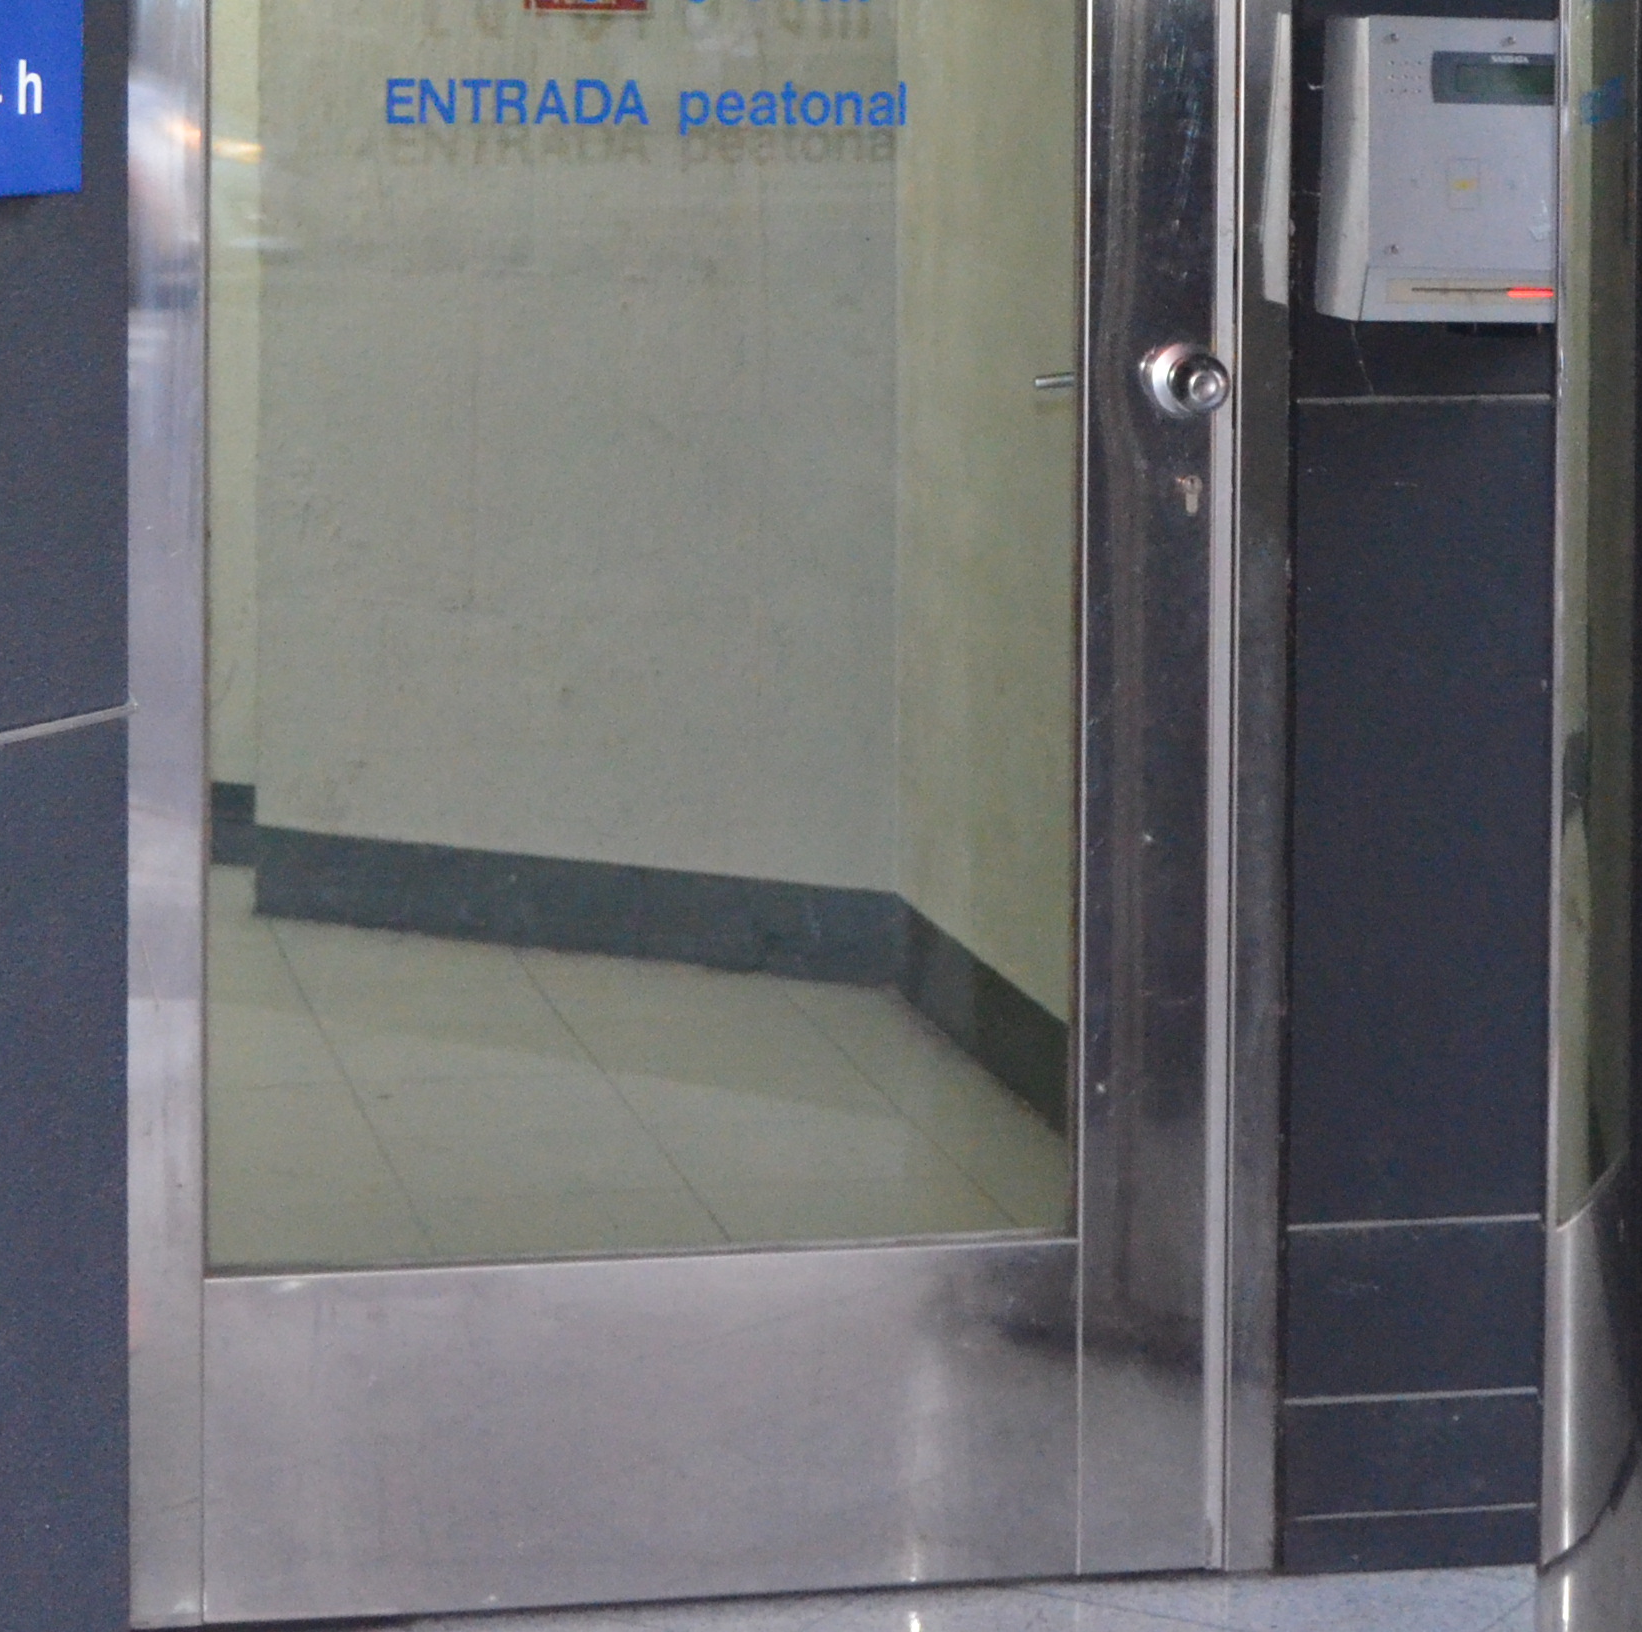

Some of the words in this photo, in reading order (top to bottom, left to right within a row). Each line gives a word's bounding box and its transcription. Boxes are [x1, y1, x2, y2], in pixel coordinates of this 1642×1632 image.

[17, 58, 43, 116] h
[387, 78, 649, 125] ENTRADA
[680, 79, 908, 136] peatonal
